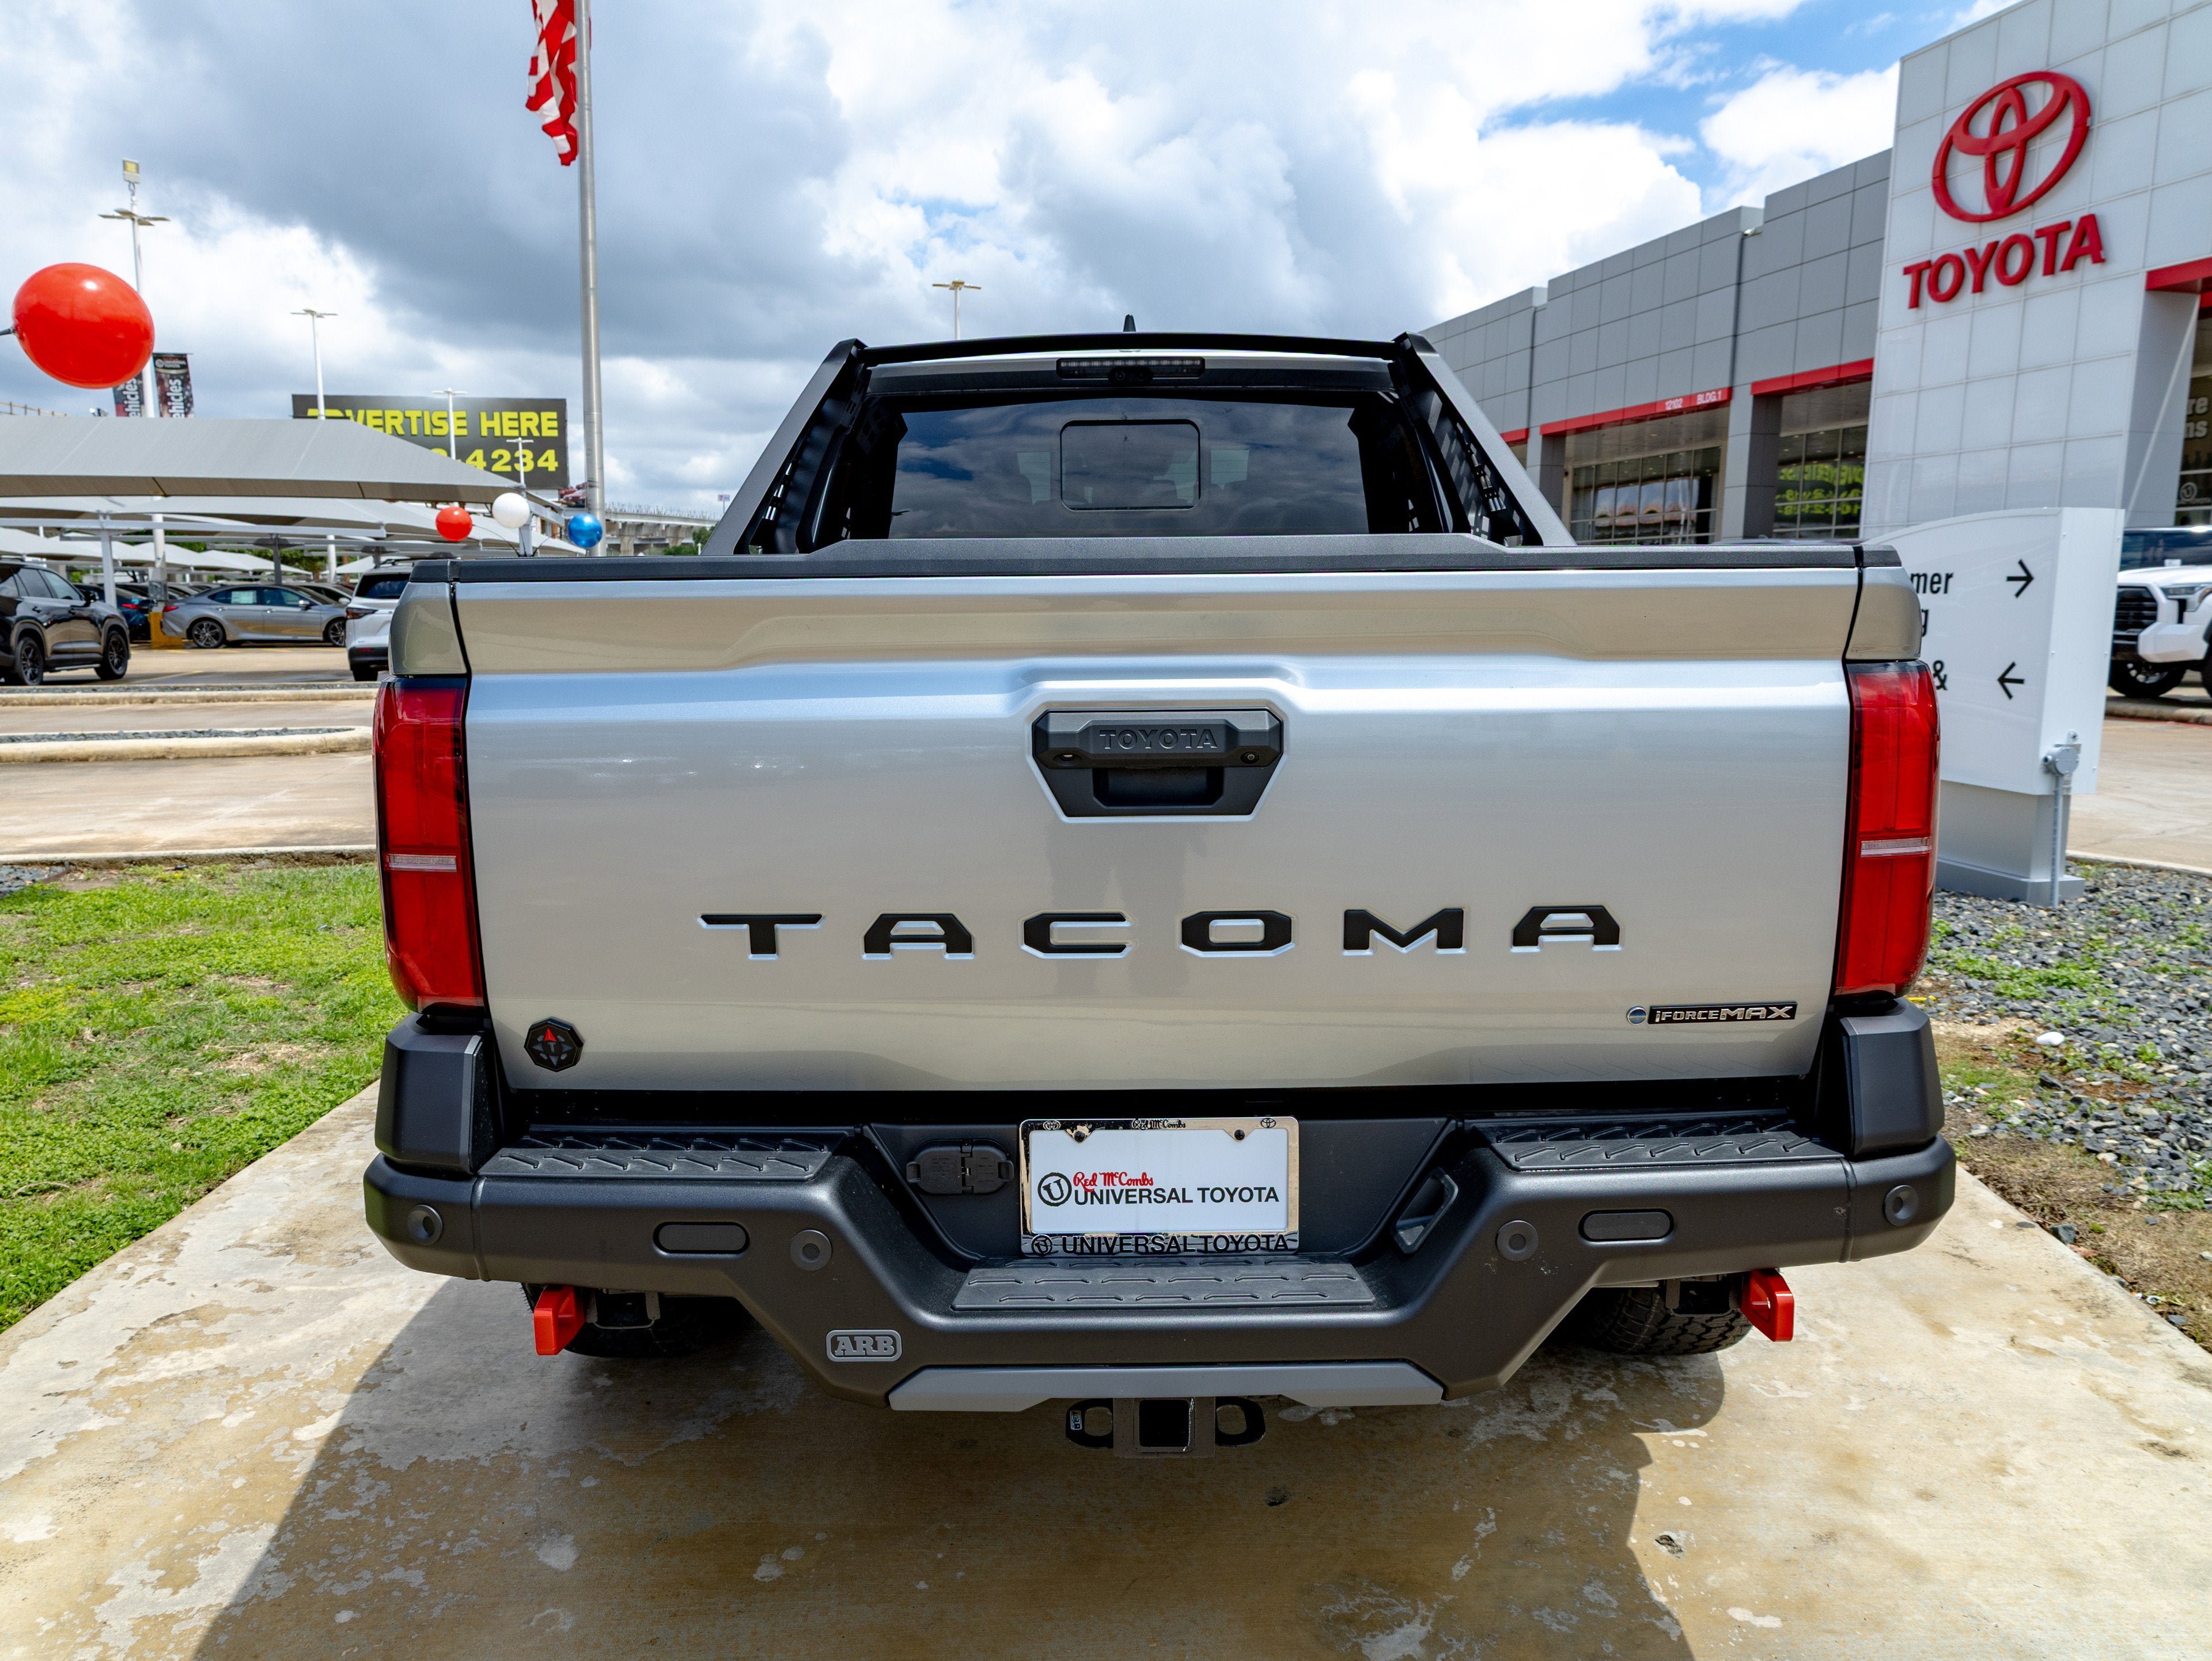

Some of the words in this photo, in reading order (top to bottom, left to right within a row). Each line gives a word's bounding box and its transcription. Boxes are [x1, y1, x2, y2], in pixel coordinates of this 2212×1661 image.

[1903, 213, 2105, 309] TOYOTA
[480, 411, 558, 437] HERE
[1099, 729, 1218, 749] TOYOTA
[698, 906, 1622, 959] TACOMA
[1073, 1171, 1097, 1192] Red
[1099, 1171, 1154, 1186] McCombs
[1074, 1187, 1193, 1205] UNIVERSAL
[1197, 1187, 1279, 1203] TOYOTA
[1062, 1235, 1196, 1255] UNIVERSAL
[1199, 1234, 1289, 1253] TOYOTA
[835, 1336, 895, 1355] ARB
